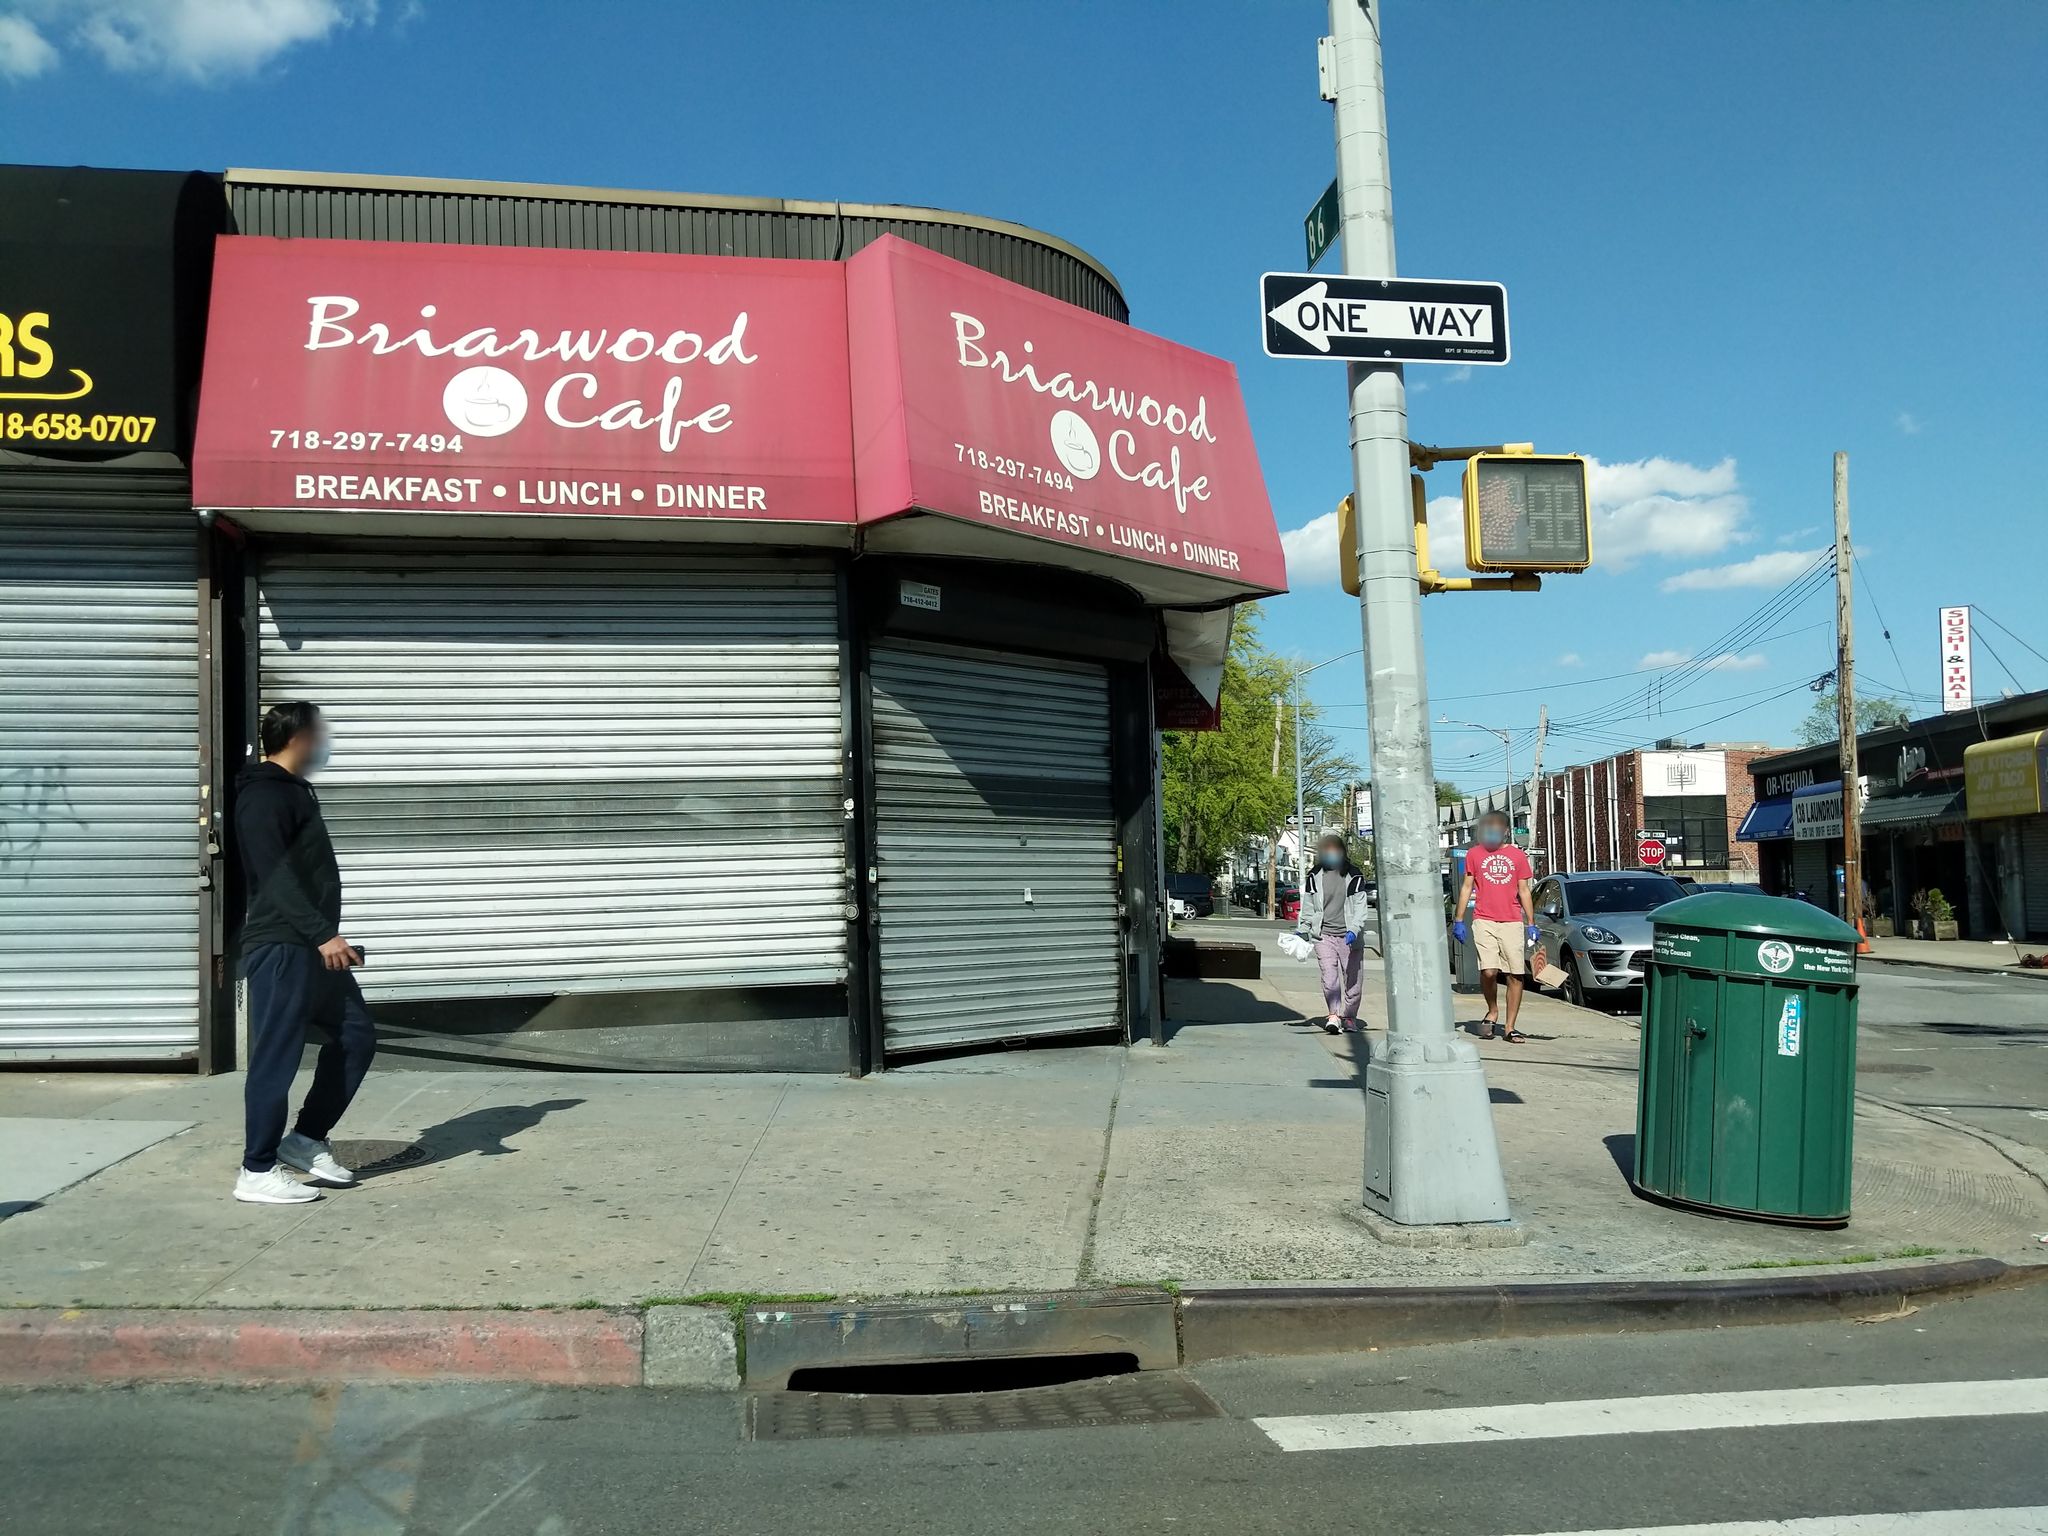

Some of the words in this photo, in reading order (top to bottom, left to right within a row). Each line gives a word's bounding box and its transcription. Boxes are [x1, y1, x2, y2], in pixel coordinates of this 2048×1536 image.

[1307, 206, 1325, 259] 86
[304, 295, 759, 366] Briarwood
[1297, 301, 1368, 333] ONE
[1408, 306, 1483, 337] WAY
[950, 311, 1217, 443] Briarwood
[544, 371, 733, 453] Cafe
[269, 430, 464, 454] 718-297-7494
[954, 443, 1074, 493] 718-297-7494
[1108, 429, 1211, 514] Cafe
[295, 474, 482, 505] BREAKFAST
[519, 480, 622, 507] LUNCH
[656, 484, 768, 511] DINNER
[979, 489, 1089, 537] BREAKFAST
[1109, 523, 1167, 554] LUNCH
[1183, 540, 1241, 572] DINNER
[924, 587, 939, 596] GATES
[1947, 610, 1965, 651] SUSHI
[1946, 655, 1965, 663] &
[1948, 667, 1966, 699] THAI
[1766, 769, 1815, 796] OR-YEHUDA
[1640, 848, 1664, 858] STOP
[1669, 949, 1691, 957] Council
[1680, 933, 1700, 942] Clean,
[1795, 945, 1814, 954] Keep
[1815, 947, 1827, 955] Our
[1803, 963, 1815, 971] the
[1816, 964, 1829, 972] New
[1830, 965, 1841, 973] York
